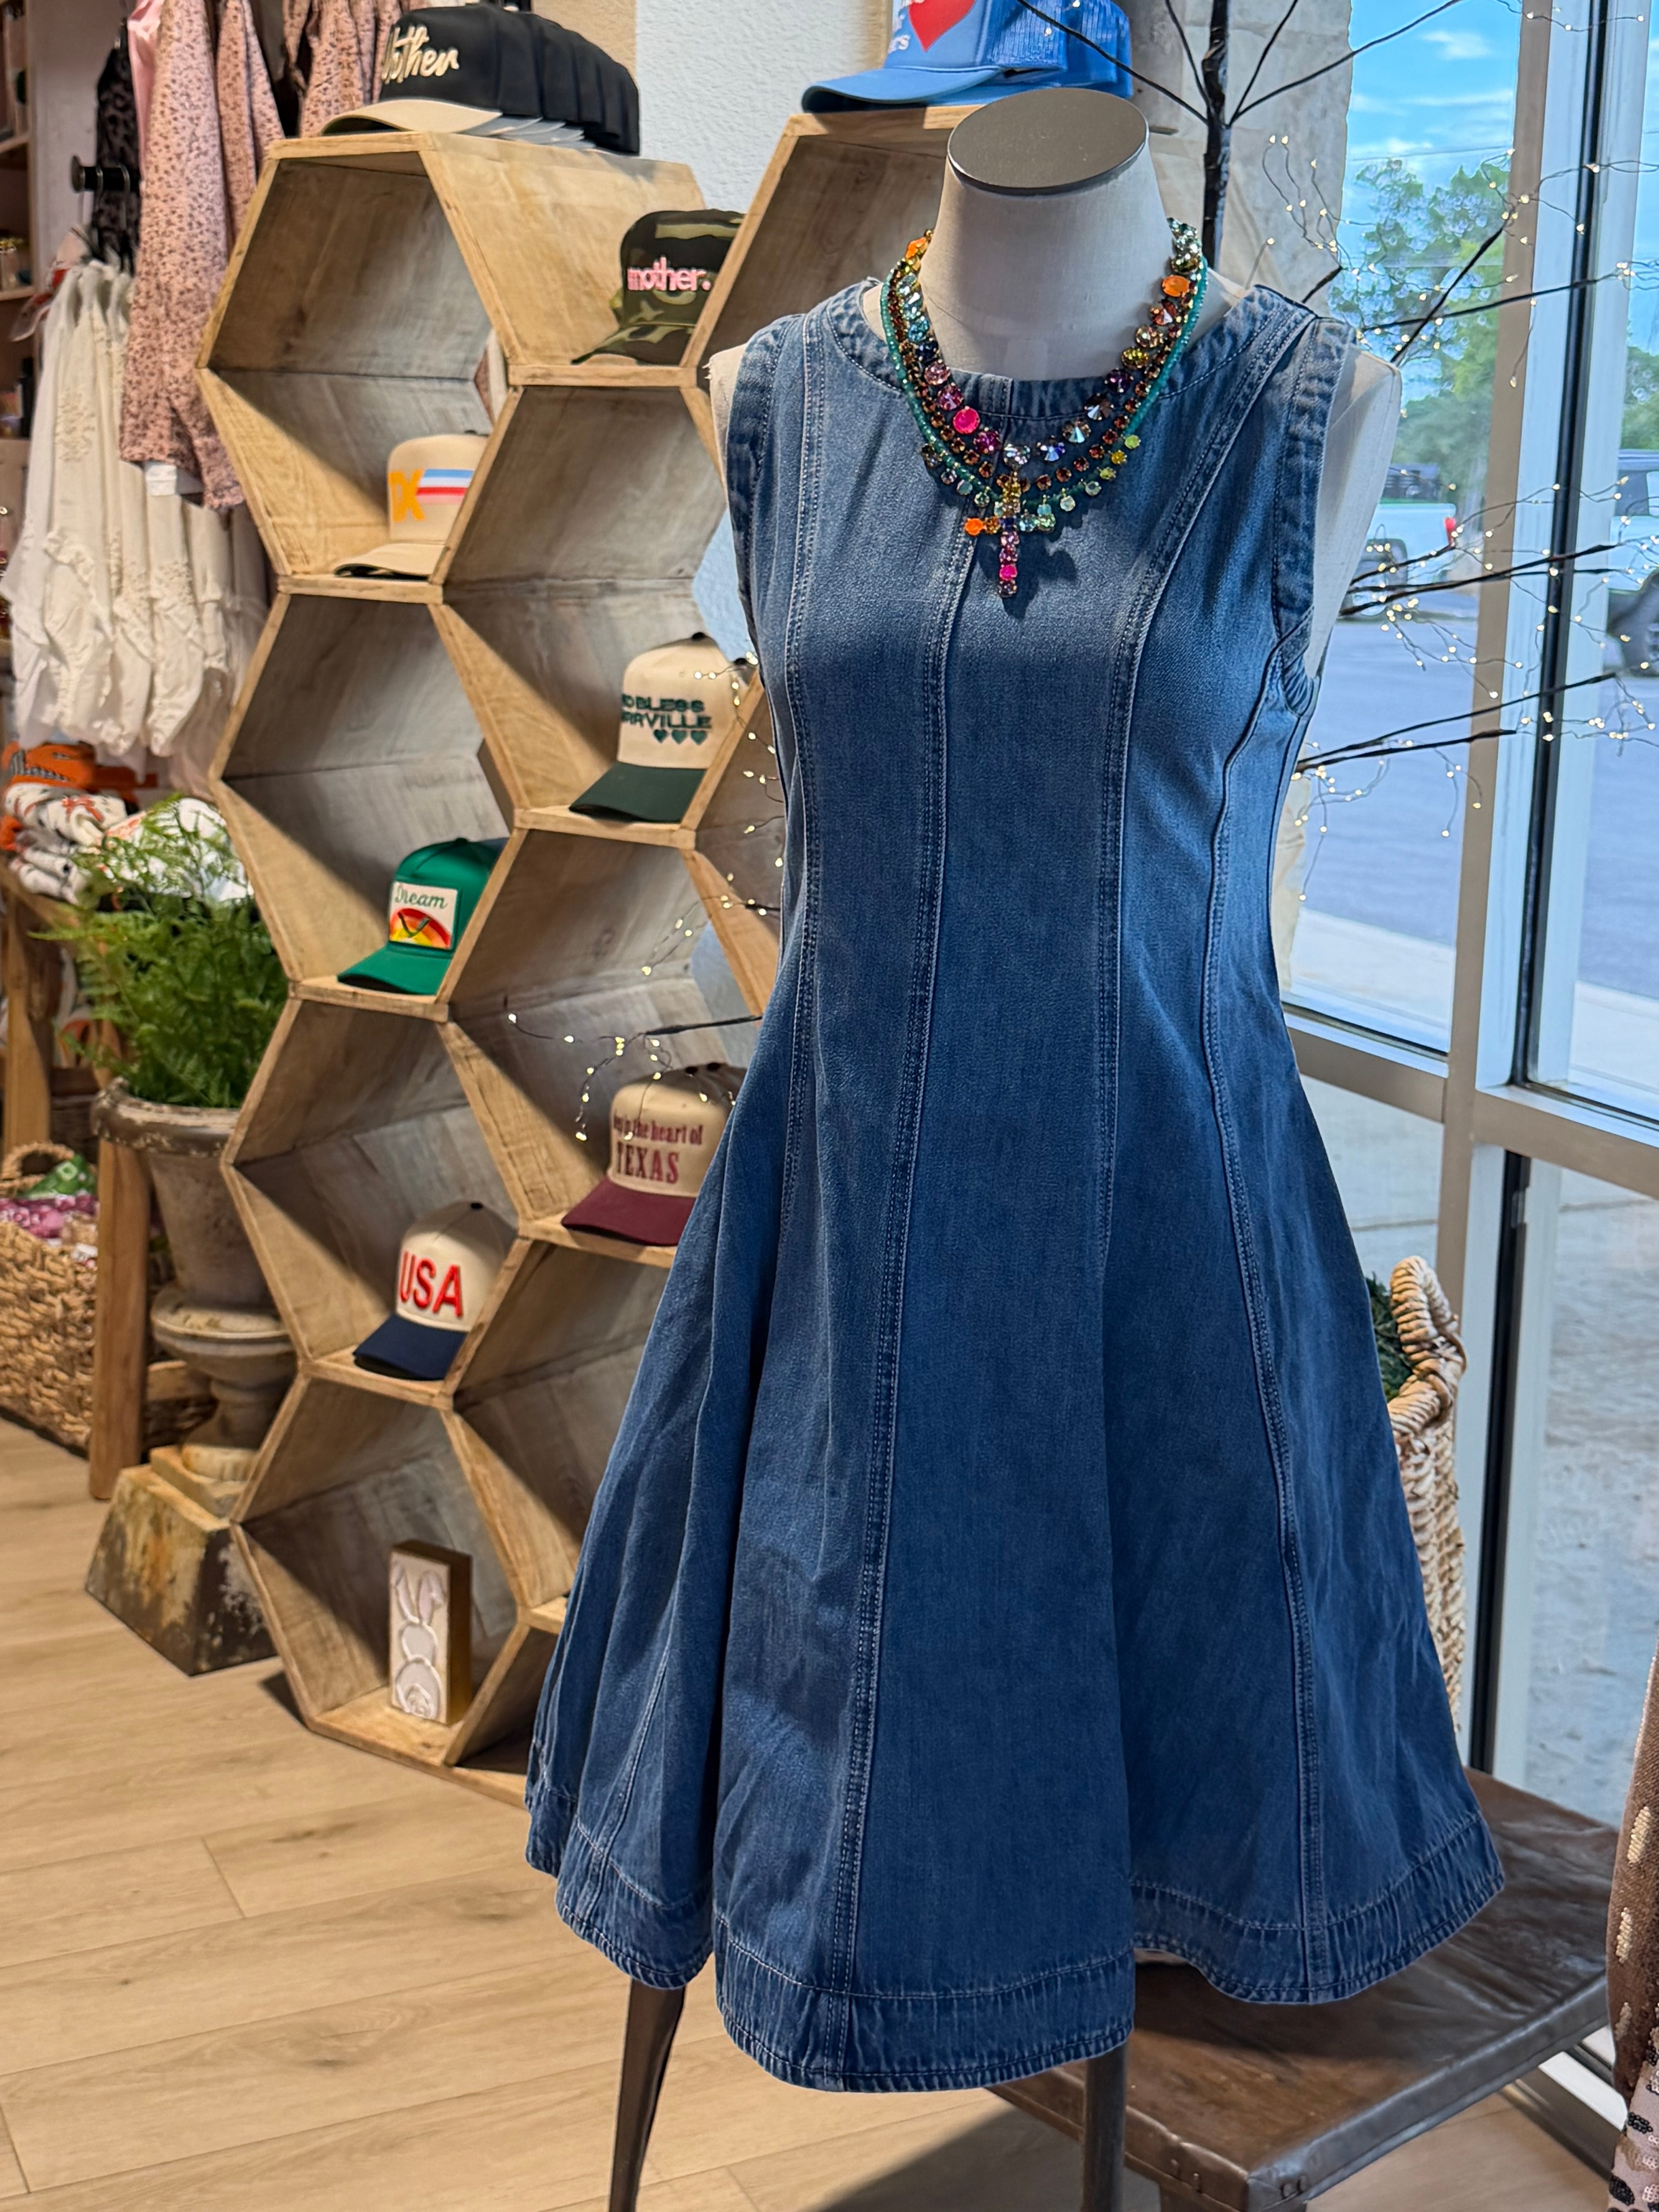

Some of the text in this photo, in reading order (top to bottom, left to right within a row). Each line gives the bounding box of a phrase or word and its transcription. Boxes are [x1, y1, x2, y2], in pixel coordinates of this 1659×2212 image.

[627, 254, 711, 291] mother.
[395, 884, 448, 909] Dream
[651, 1120, 686, 1144] heart
[617, 1141, 680, 1184] TEXAS
[399, 1251, 463, 1318] USA
